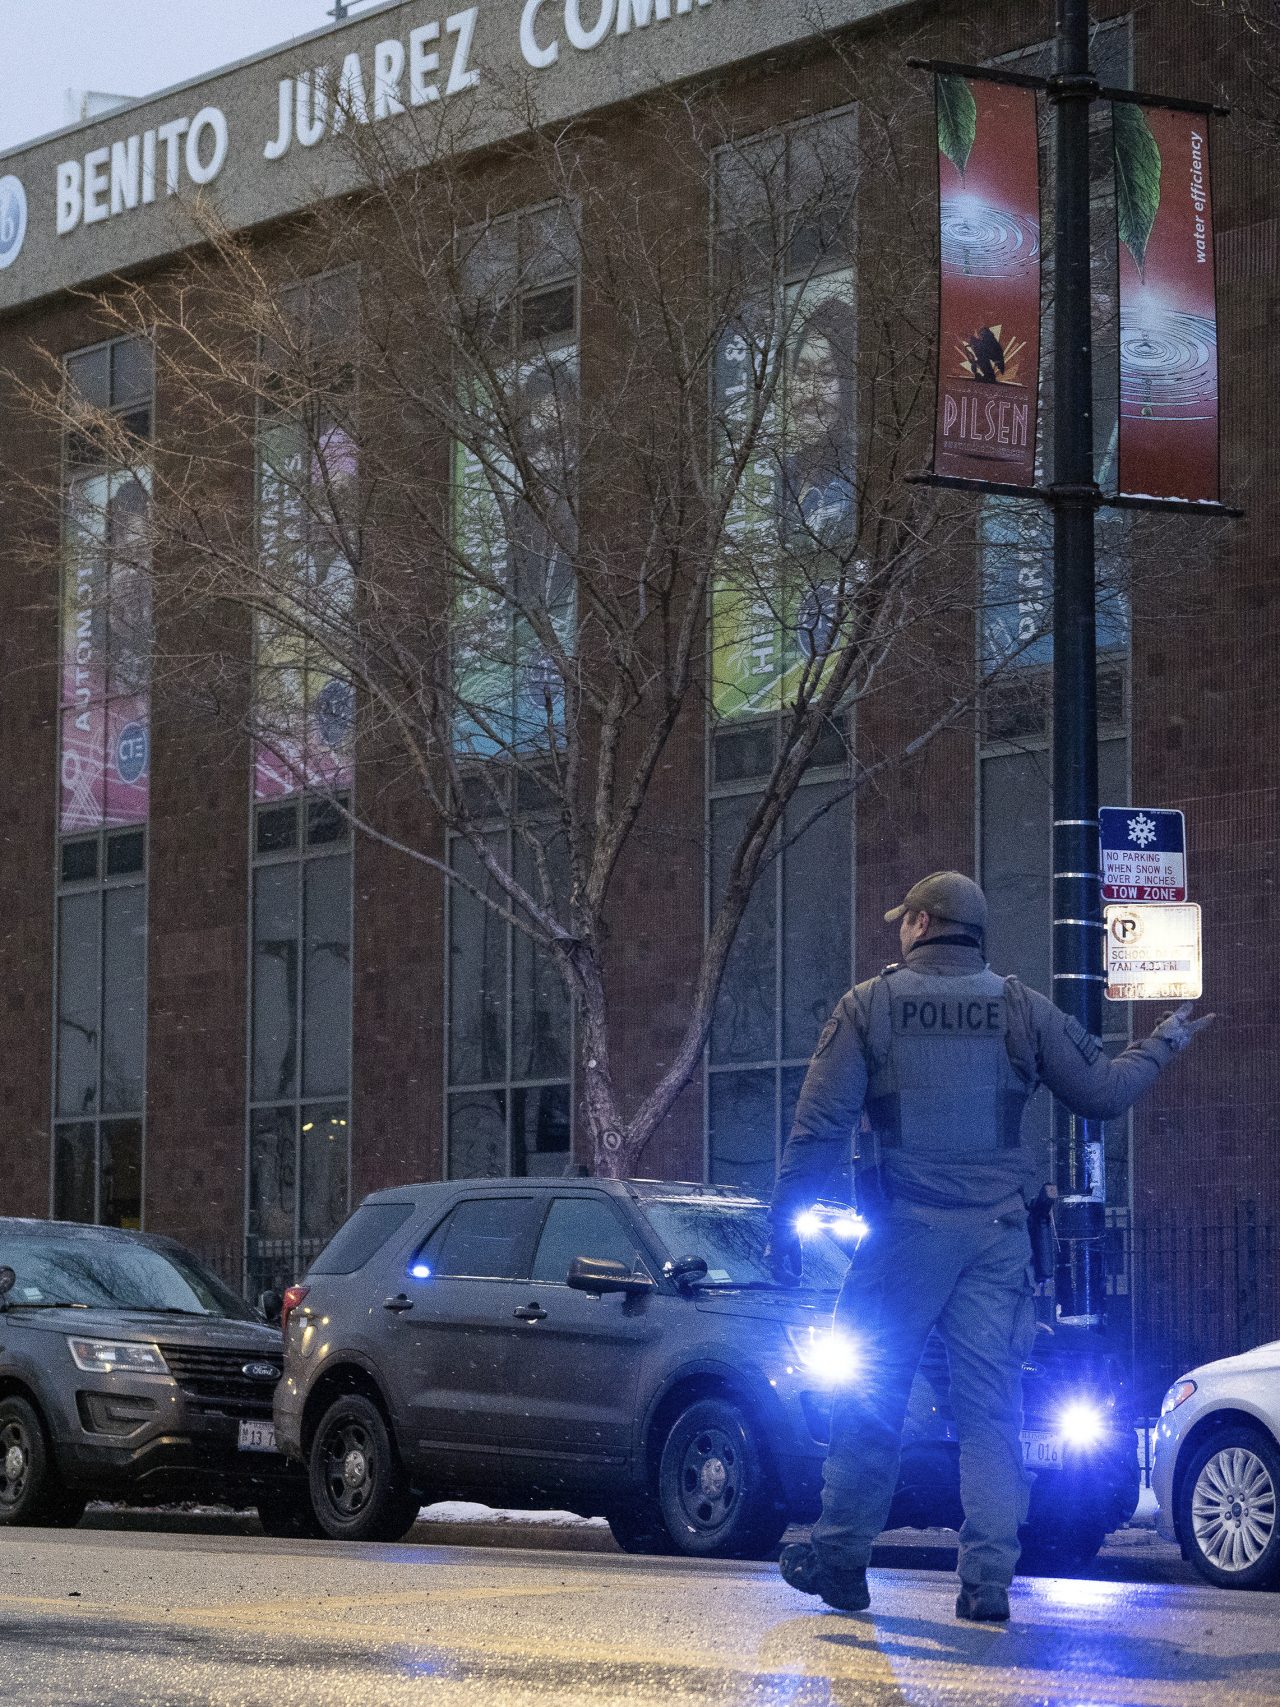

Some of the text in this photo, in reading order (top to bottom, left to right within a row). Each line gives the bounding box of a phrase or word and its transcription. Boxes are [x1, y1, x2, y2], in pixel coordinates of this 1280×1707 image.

[55, 105, 228, 237] BENITO
[263, 7, 481, 161] JUAREZ
[1190, 131, 1206, 264] water efficiency
[943, 394, 1028, 446] PILSEN
[282, 453, 302, 541] ARS
[74, 513, 93, 732] AUTOMOTV
[1106, 852, 1160, 863] NO PARKING
[1107, 863, 1173, 875] WHEN SNOW IS
[1107, 875, 1176, 885] OVER 2 INCHES
[1112, 886, 1177, 900] TOW ZONE
[1109, 962, 1132, 972] 7AM
[902, 1002, 1000, 1030] POLICE
